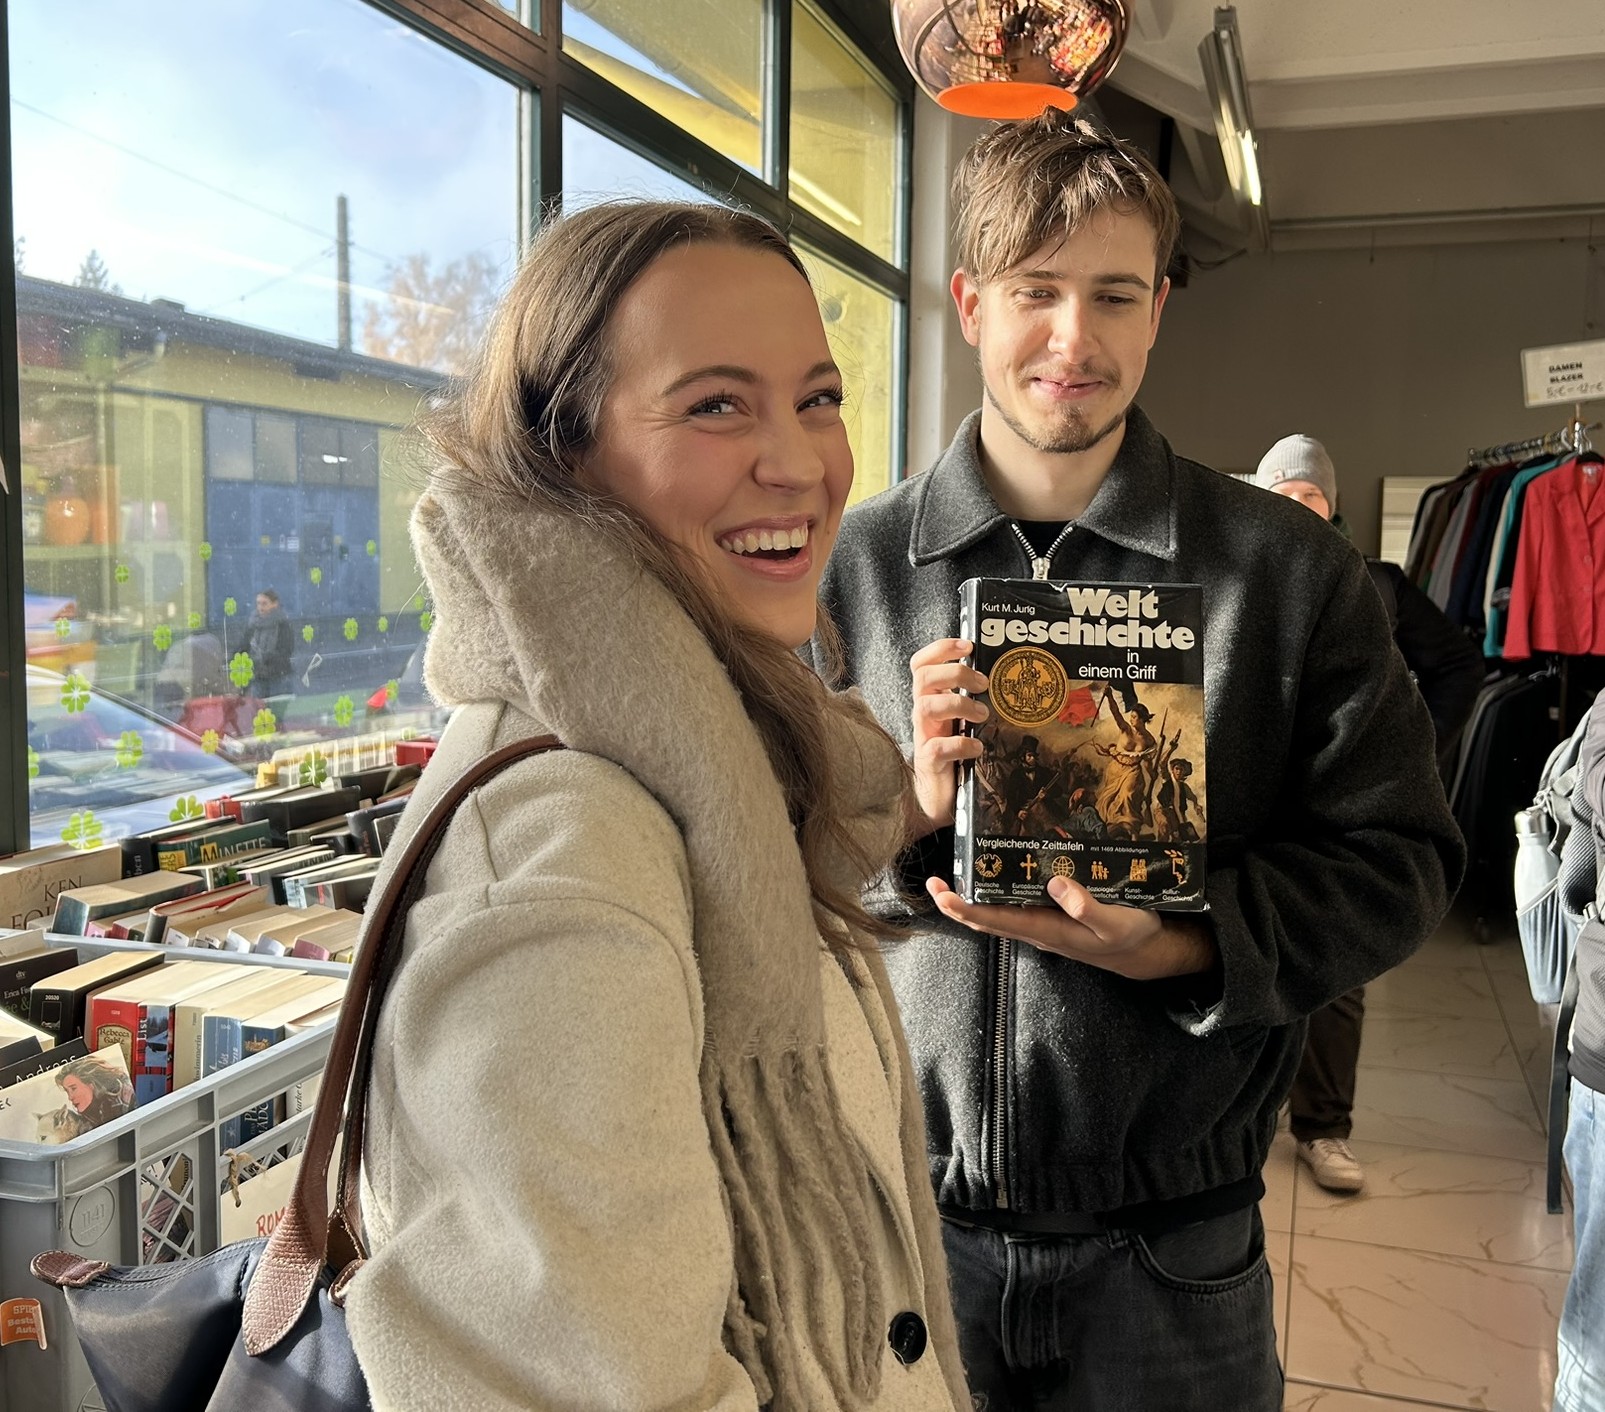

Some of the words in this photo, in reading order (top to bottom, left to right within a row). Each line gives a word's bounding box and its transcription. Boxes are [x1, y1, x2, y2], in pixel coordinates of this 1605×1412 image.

[1549, 362, 1582, 373] DAMEN
[981, 603, 1000, 612] Kurt
[1001, 604, 1013, 613] M.
[1066, 587, 1159, 619] Welt
[980, 617, 1195, 650] geschichte
[1127, 649, 1139, 663] in
[1078, 663, 1123, 678] einem
[1126, 664, 1157, 680] Griff
[976, 837, 1040, 850] Vergleichende
[1041, 840, 1085, 851] Zeittafeln
[44, 875, 82, 902] KEN
[1012, 882, 1045, 890] Europäische
[100, 1028, 130, 1038] Rebecca
